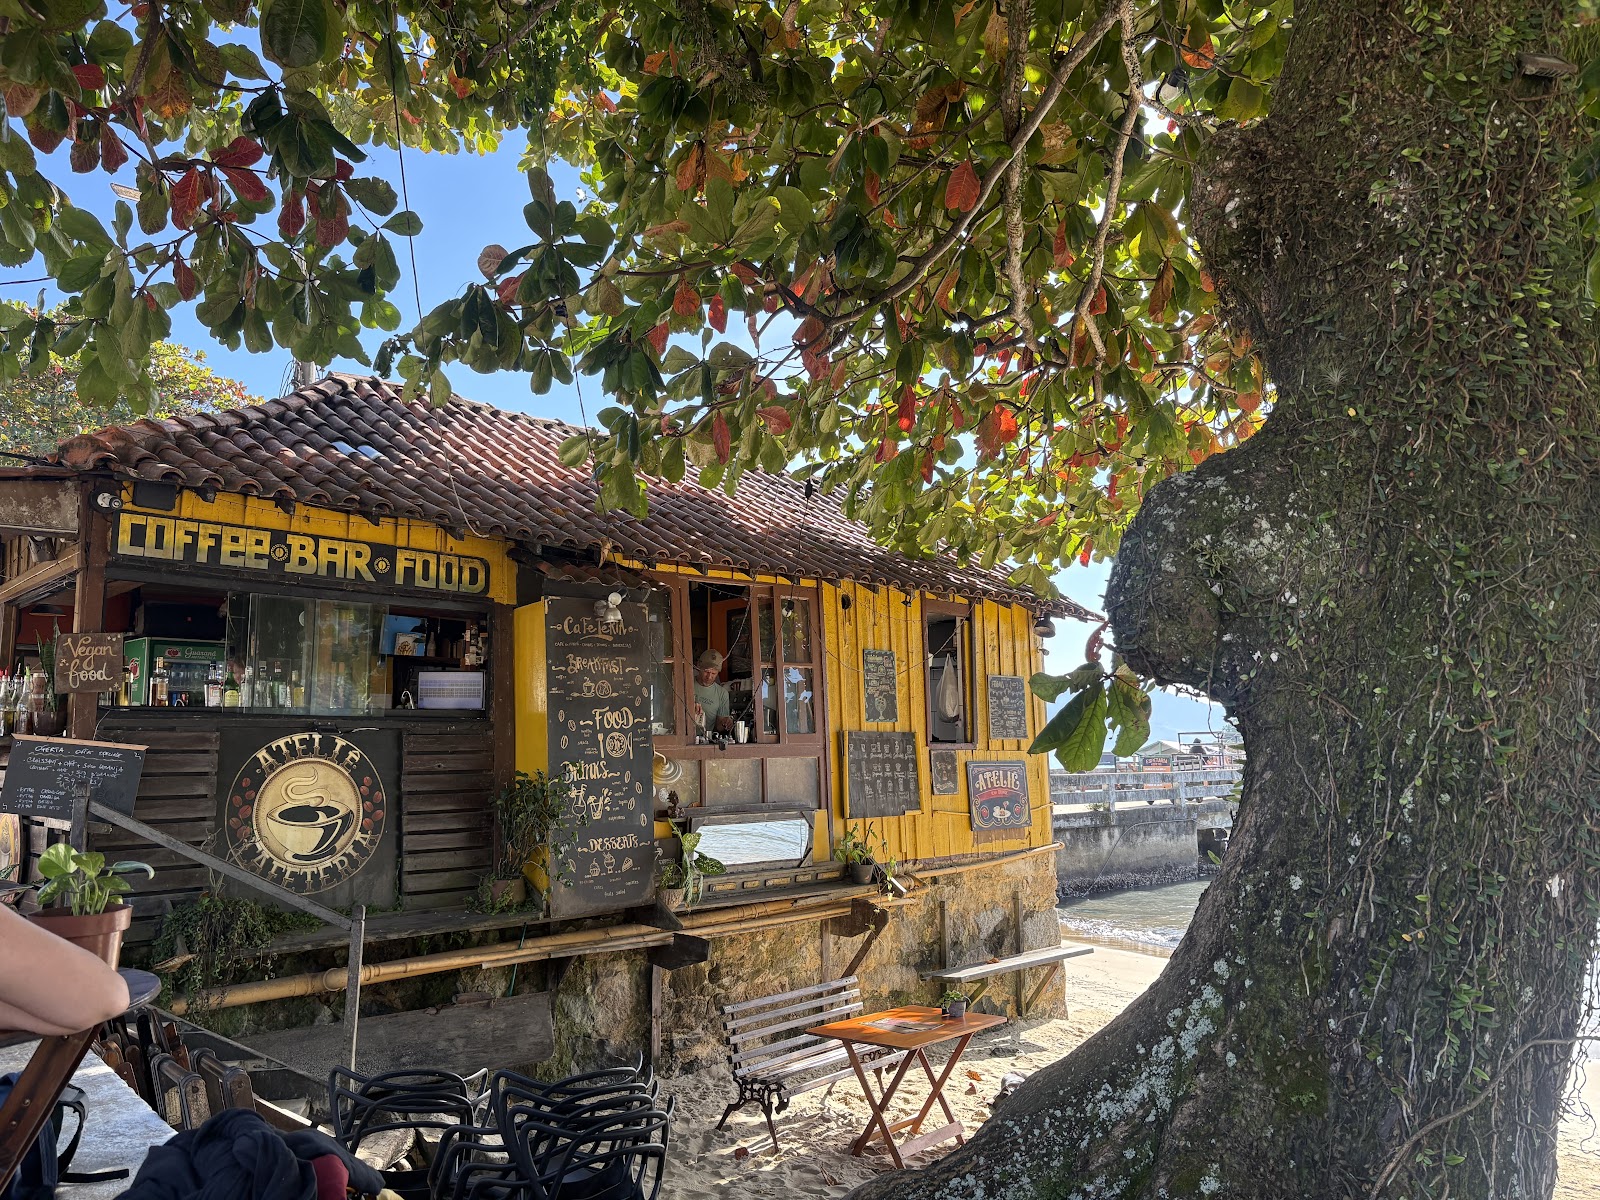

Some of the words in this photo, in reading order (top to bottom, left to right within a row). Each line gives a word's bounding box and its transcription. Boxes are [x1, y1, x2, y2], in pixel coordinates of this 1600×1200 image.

[284, 533, 377, 582] BAR
[395, 548, 486, 593] FOOD
[63, 636, 117, 670] Vegan
[64, 658, 113, 688] food
[592, 706, 634, 730] FOOD
[256, 735, 360, 777] ATELIÊ
